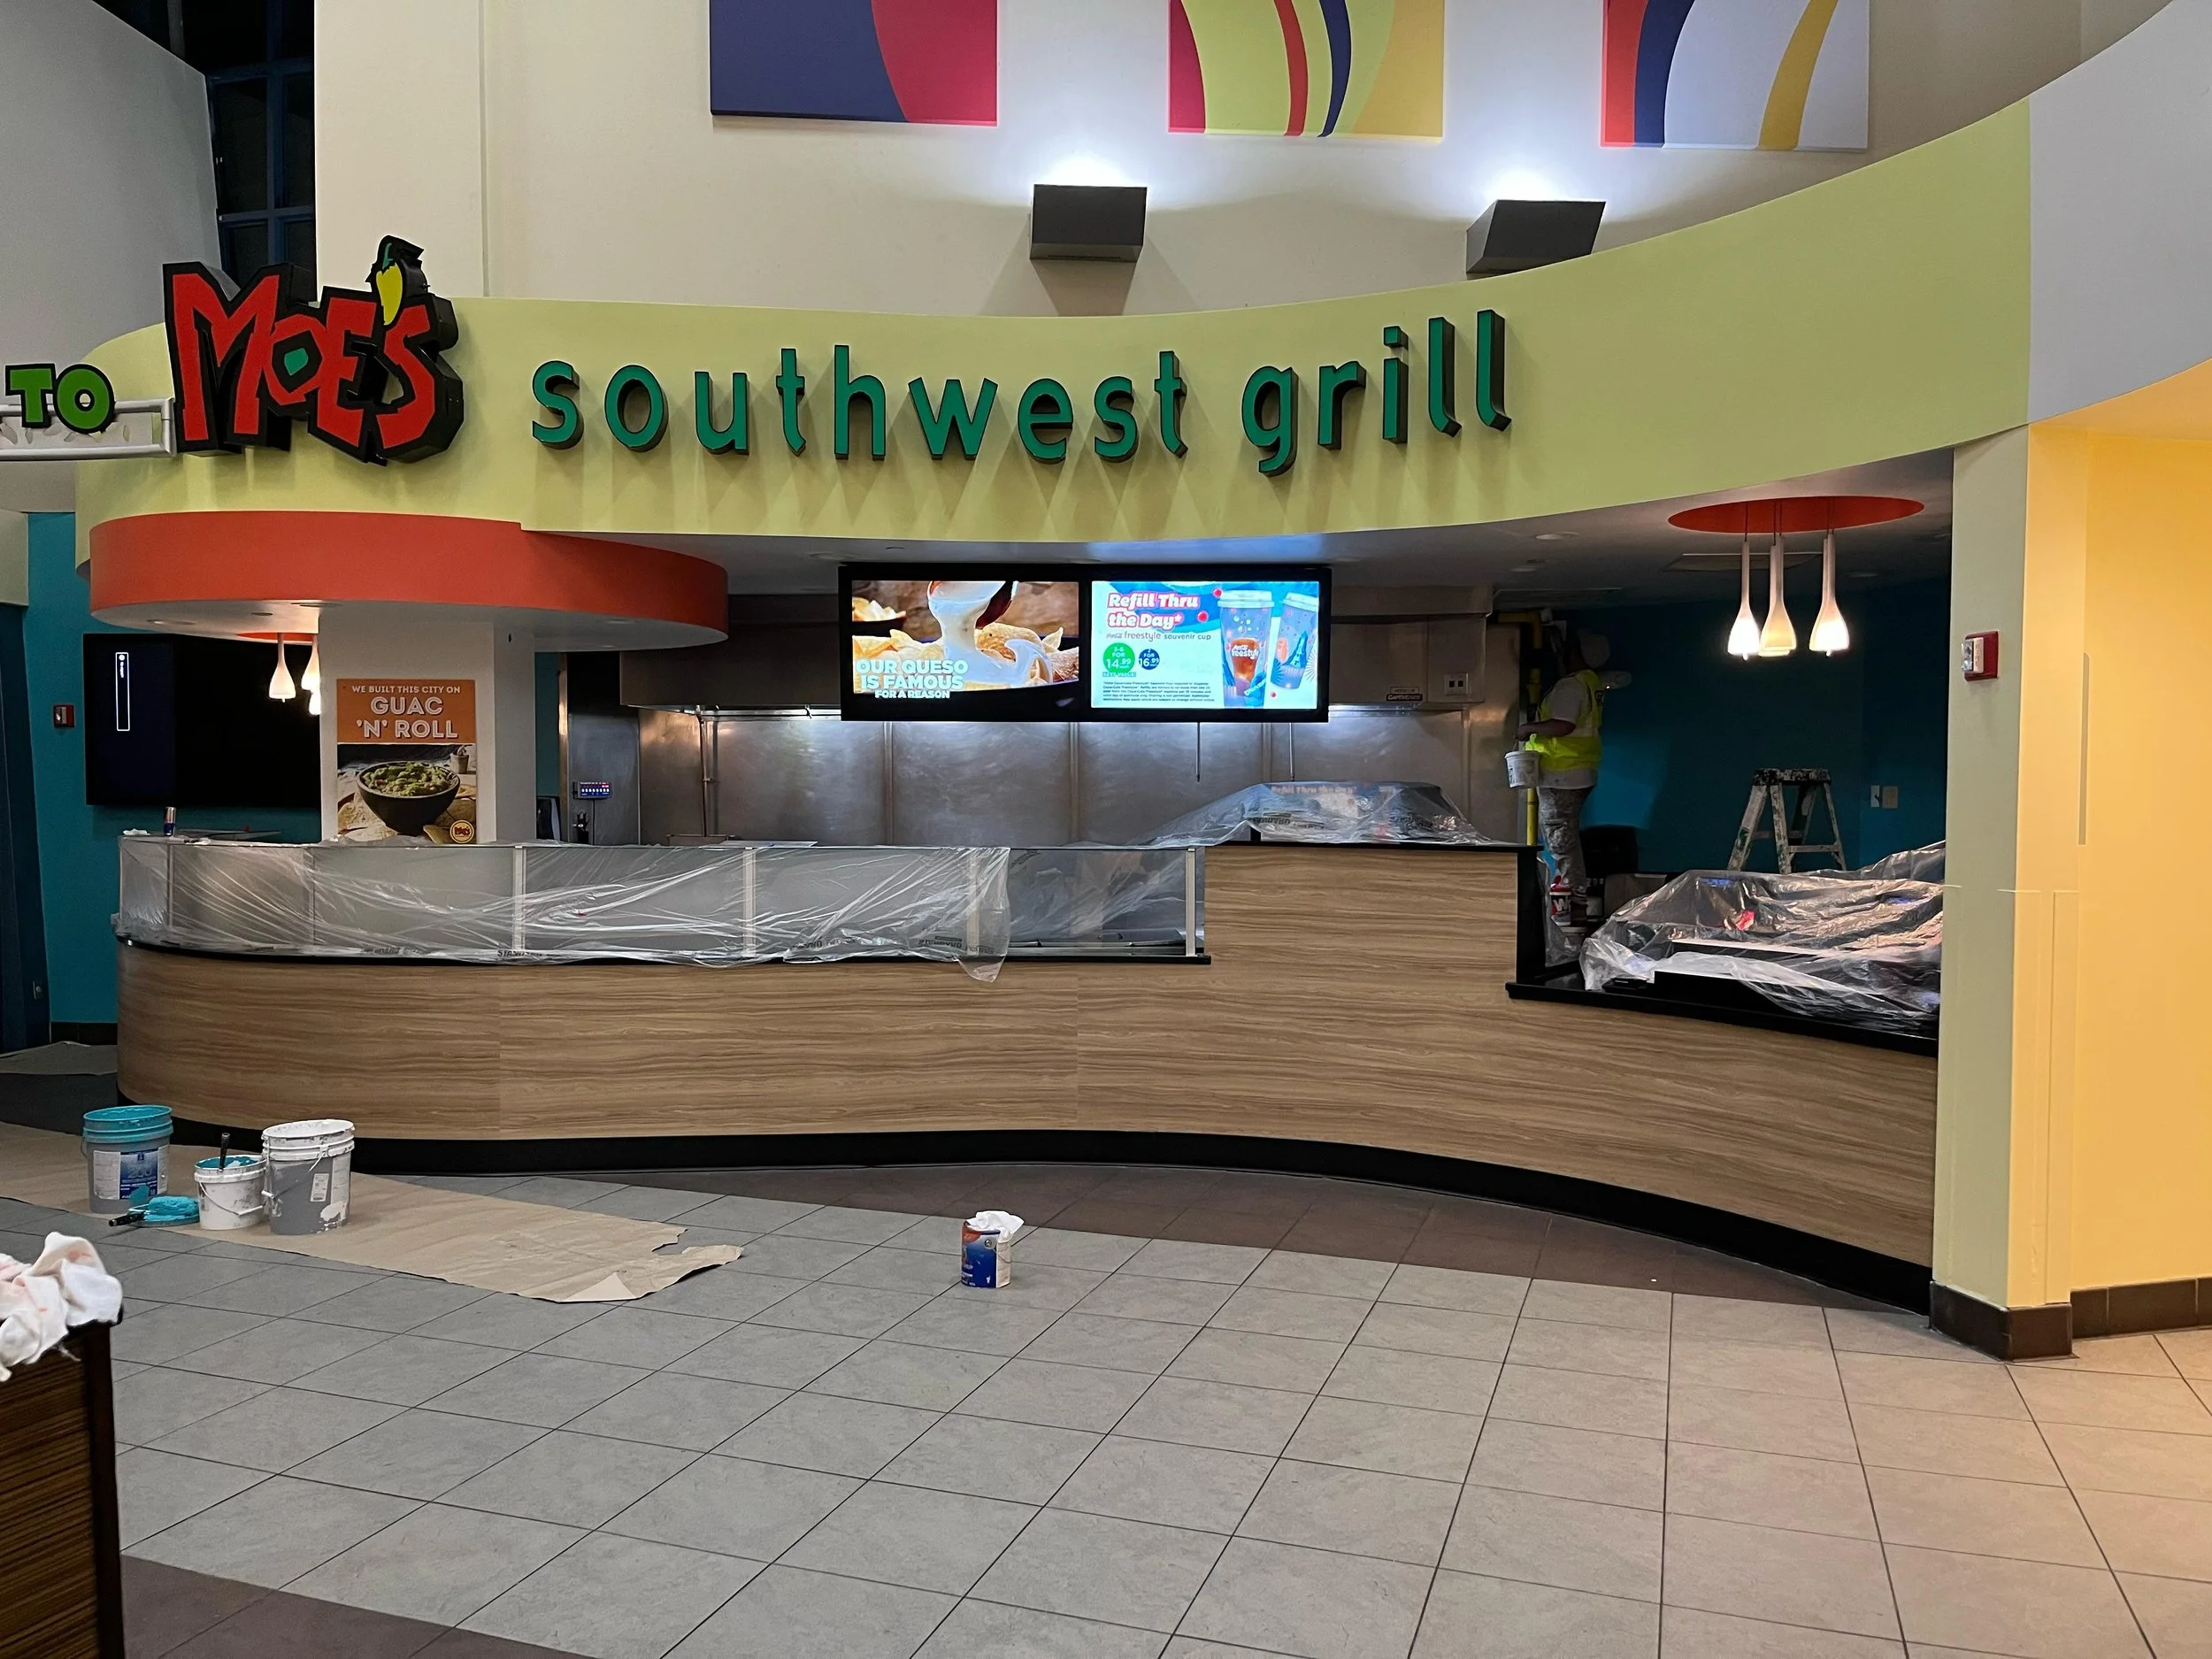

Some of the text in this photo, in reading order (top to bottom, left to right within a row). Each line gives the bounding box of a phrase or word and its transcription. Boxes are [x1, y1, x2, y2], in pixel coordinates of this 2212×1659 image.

[5, 363, 116, 434] TO
[532, 309, 1511, 476] southwest grill
[1108, 592, 1200, 611] Refill Thru
[1108, 611, 1139, 627] the
[856, 659, 969, 675] OUR QUESO
[861, 675, 964, 690] IS FAMOUS
[908, 690, 950, 699] REASON
[370, 696, 444, 716] GUAC
[395, 719, 459, 740] ROLL
